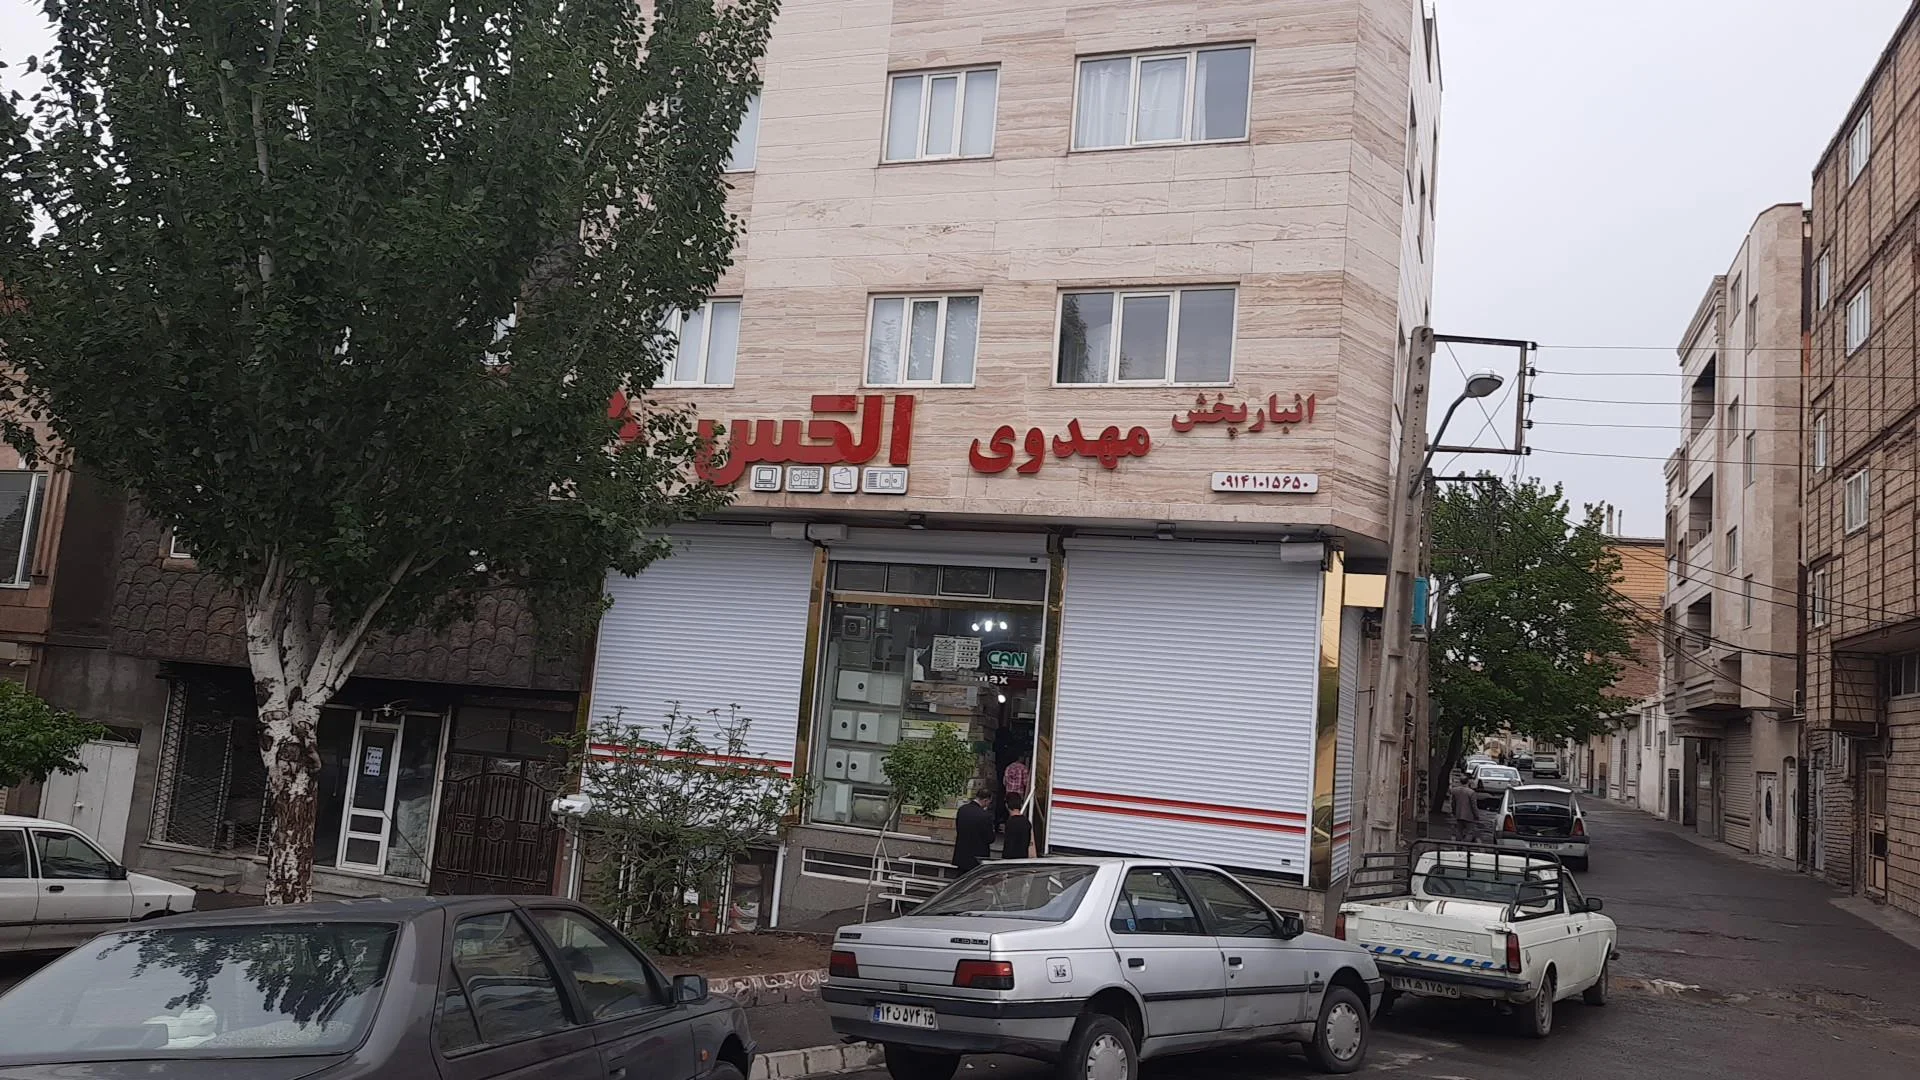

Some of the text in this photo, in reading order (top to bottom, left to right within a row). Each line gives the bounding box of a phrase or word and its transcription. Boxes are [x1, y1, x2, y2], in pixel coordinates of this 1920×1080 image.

[1171, 393, 1316, 439] انبار پخش
[968, 417, 1151, 474] مهدوی
[1221, 475, 1309, 489] ۰۹۱۴۱۰۱۵۶۵۰
[987, 651, 1027, 667] CAN
